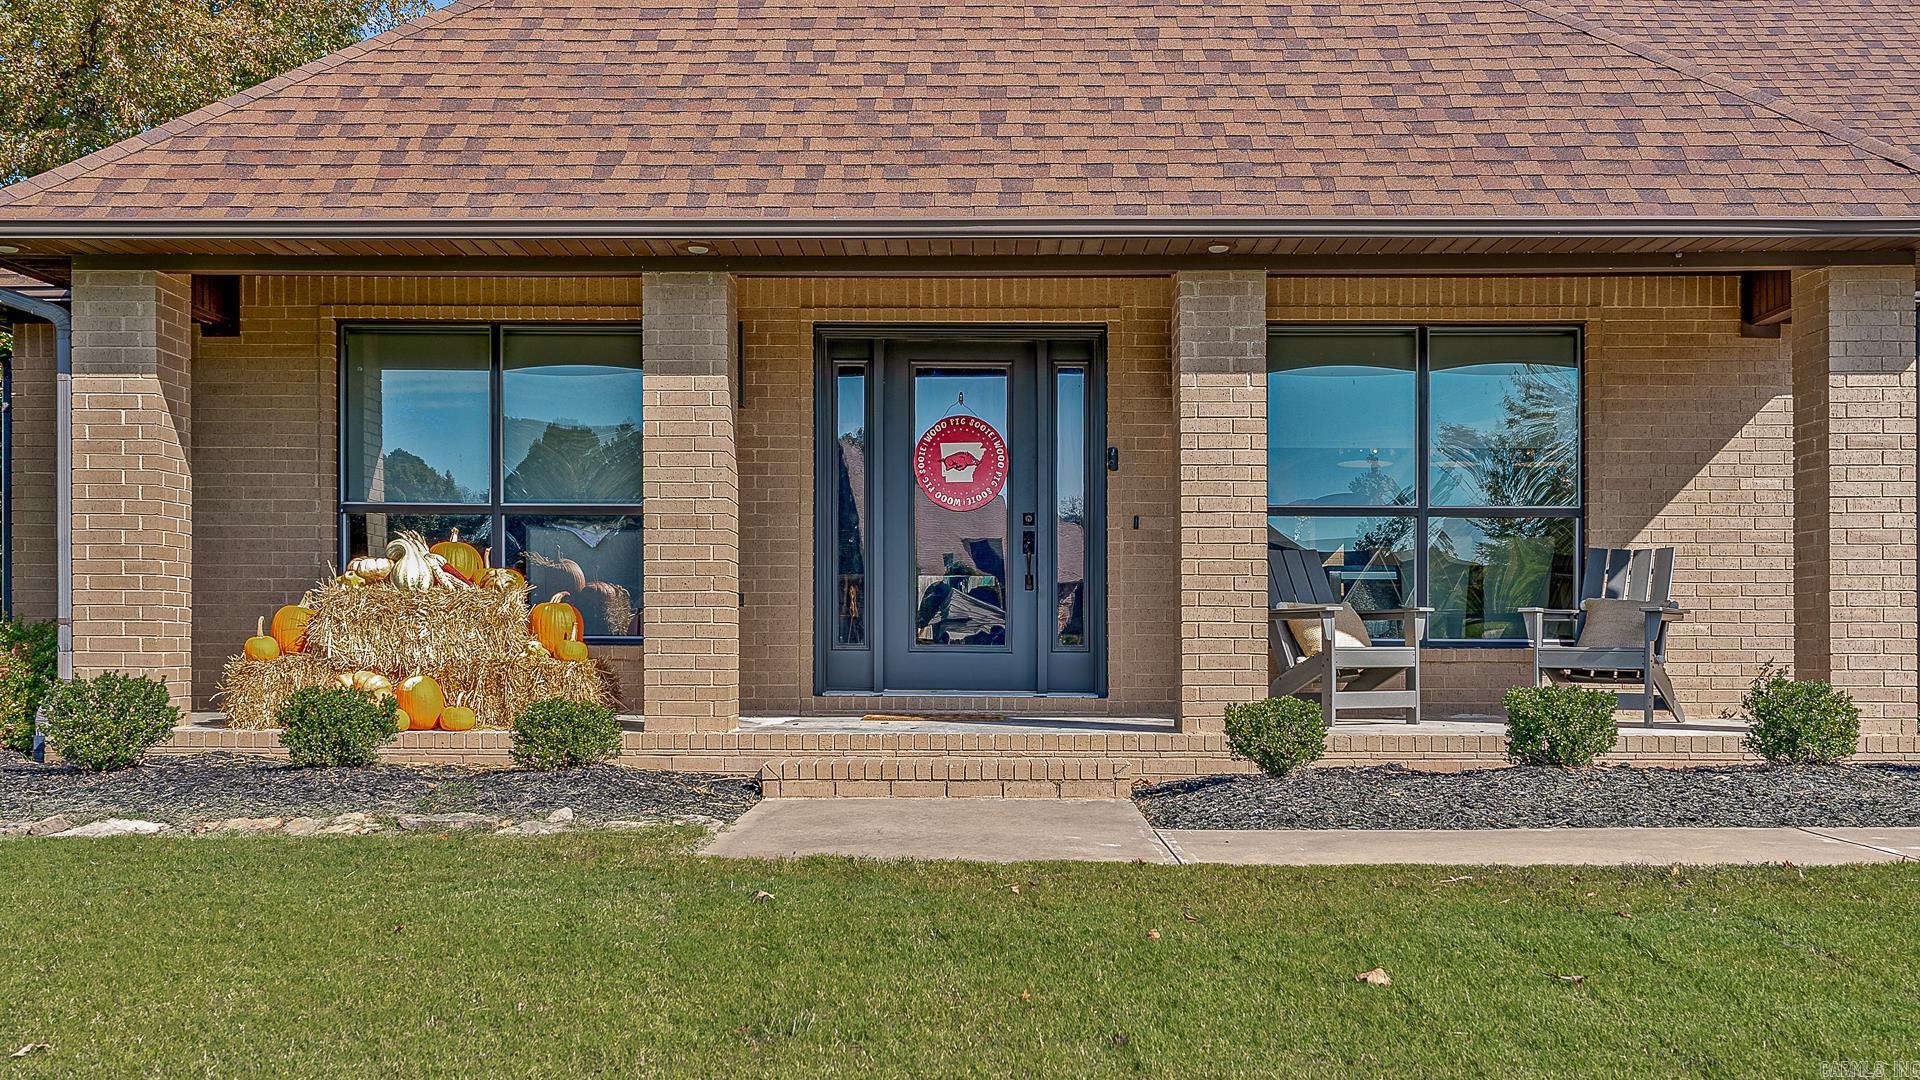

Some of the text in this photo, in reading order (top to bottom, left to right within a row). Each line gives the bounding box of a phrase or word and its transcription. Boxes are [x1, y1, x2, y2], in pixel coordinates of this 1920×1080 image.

[923, 421, 947, 442] WOOO
[949, 417, 966, 426] PIG
[993, 440, 1005, 469] WOOO
[922, 476, 936, 494] PIG
[991, 471, 1003, 487] PIG
[934, 491, 961, 507] WOOO
